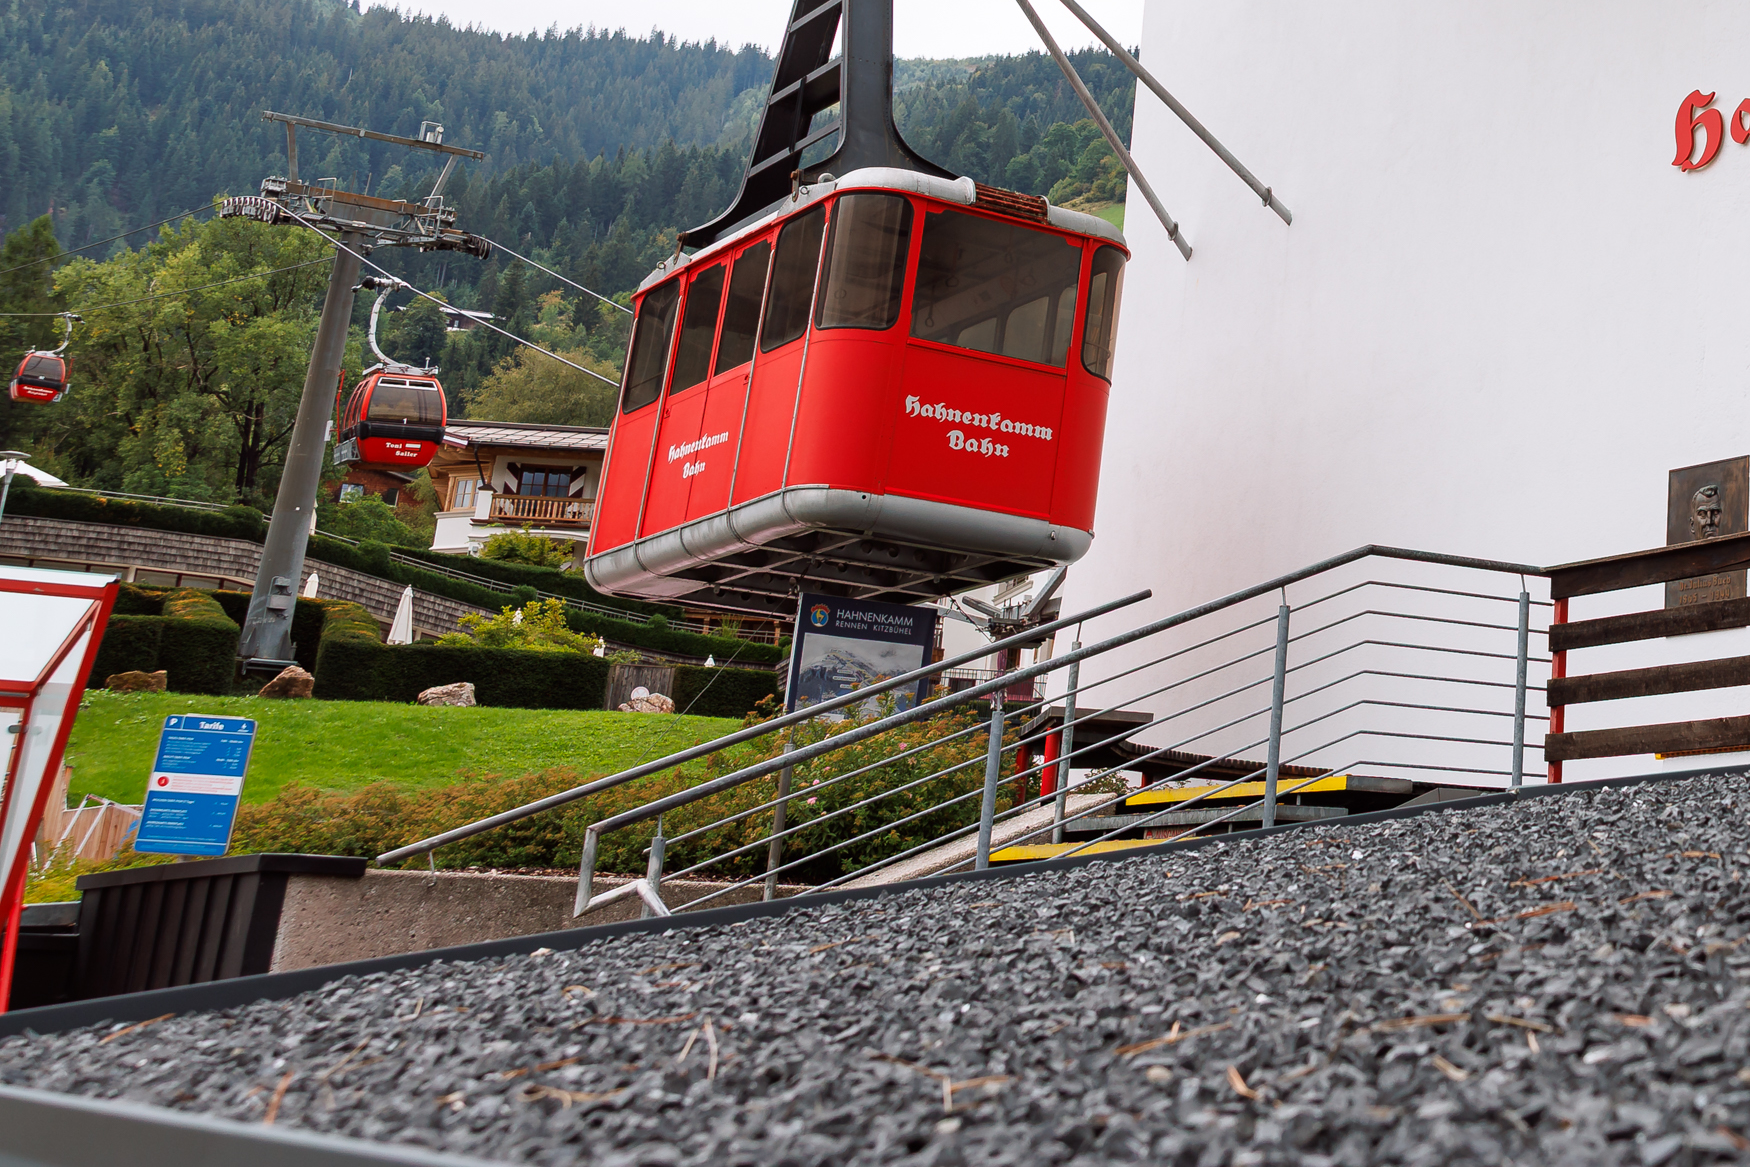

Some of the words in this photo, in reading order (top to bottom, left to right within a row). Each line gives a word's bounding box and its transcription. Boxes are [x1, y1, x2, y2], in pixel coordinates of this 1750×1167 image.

[905, 394, 1053, 441] Hahnenkamm
[668, 431, 729, 464] Hahnenkamm
[946, 430, 1010, 458] Bahn
[395, 450, 418, 458] Sailer
[682, 460, 706, 479] Bahn
[836, 609, 914, 627] HAHNENKAMM
[835, 620, 868, 630] RENNEN
[873, 624, 912, 636] KITZBÜHEL
[199, 721, 225, 731] Tarife
